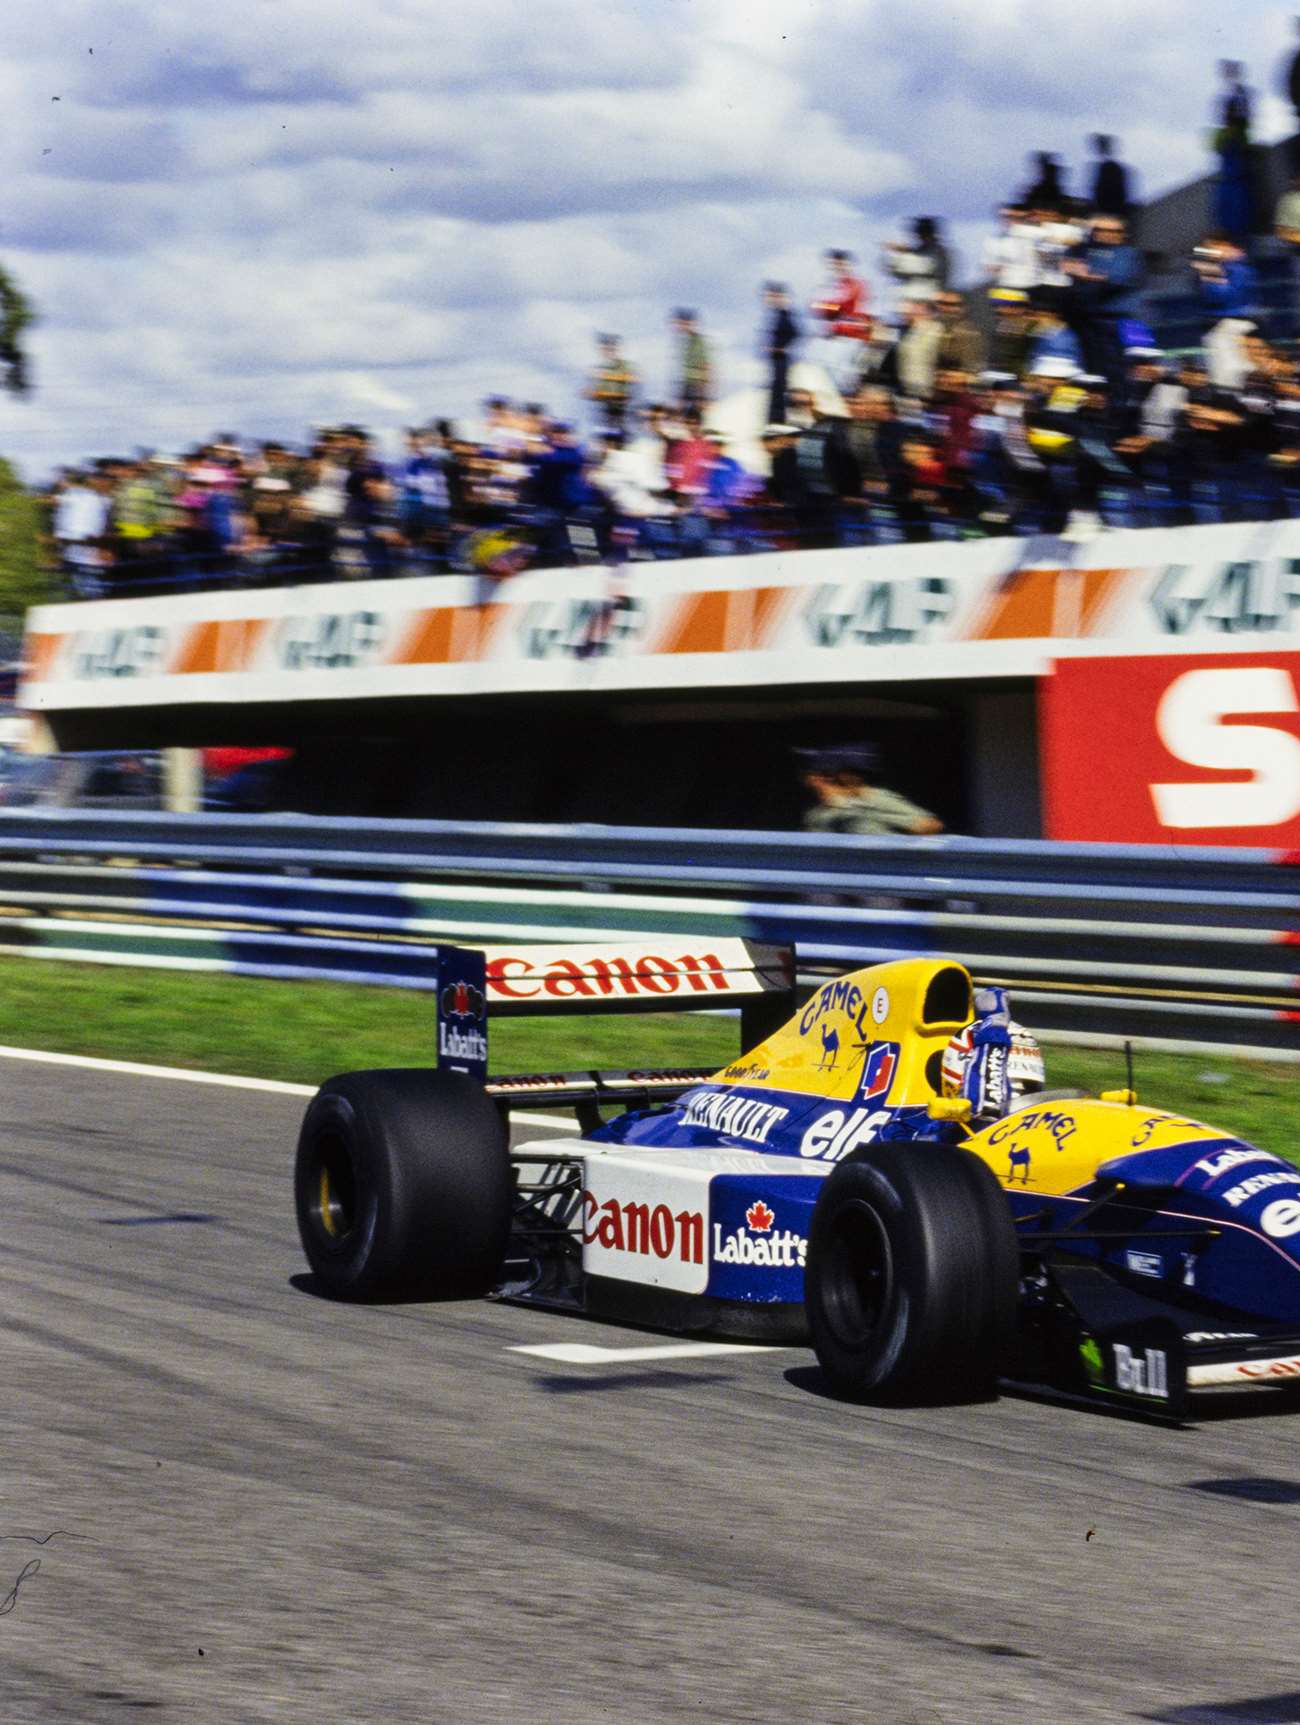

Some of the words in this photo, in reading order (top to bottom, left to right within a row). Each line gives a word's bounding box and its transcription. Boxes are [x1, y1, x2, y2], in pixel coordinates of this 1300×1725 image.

[486, 953, 731, 998] Canon
[799, 981, 868, 1041] CAMEL
[678, 1092, 790, 1144] RENAULT
[800, 1107, 893, 1162] elf
[988, 1111, 1077, 1152] CAMEL
[583, 1190, 704, 1265] Canon
[713, 1222, 808, 1268] Labatt's
